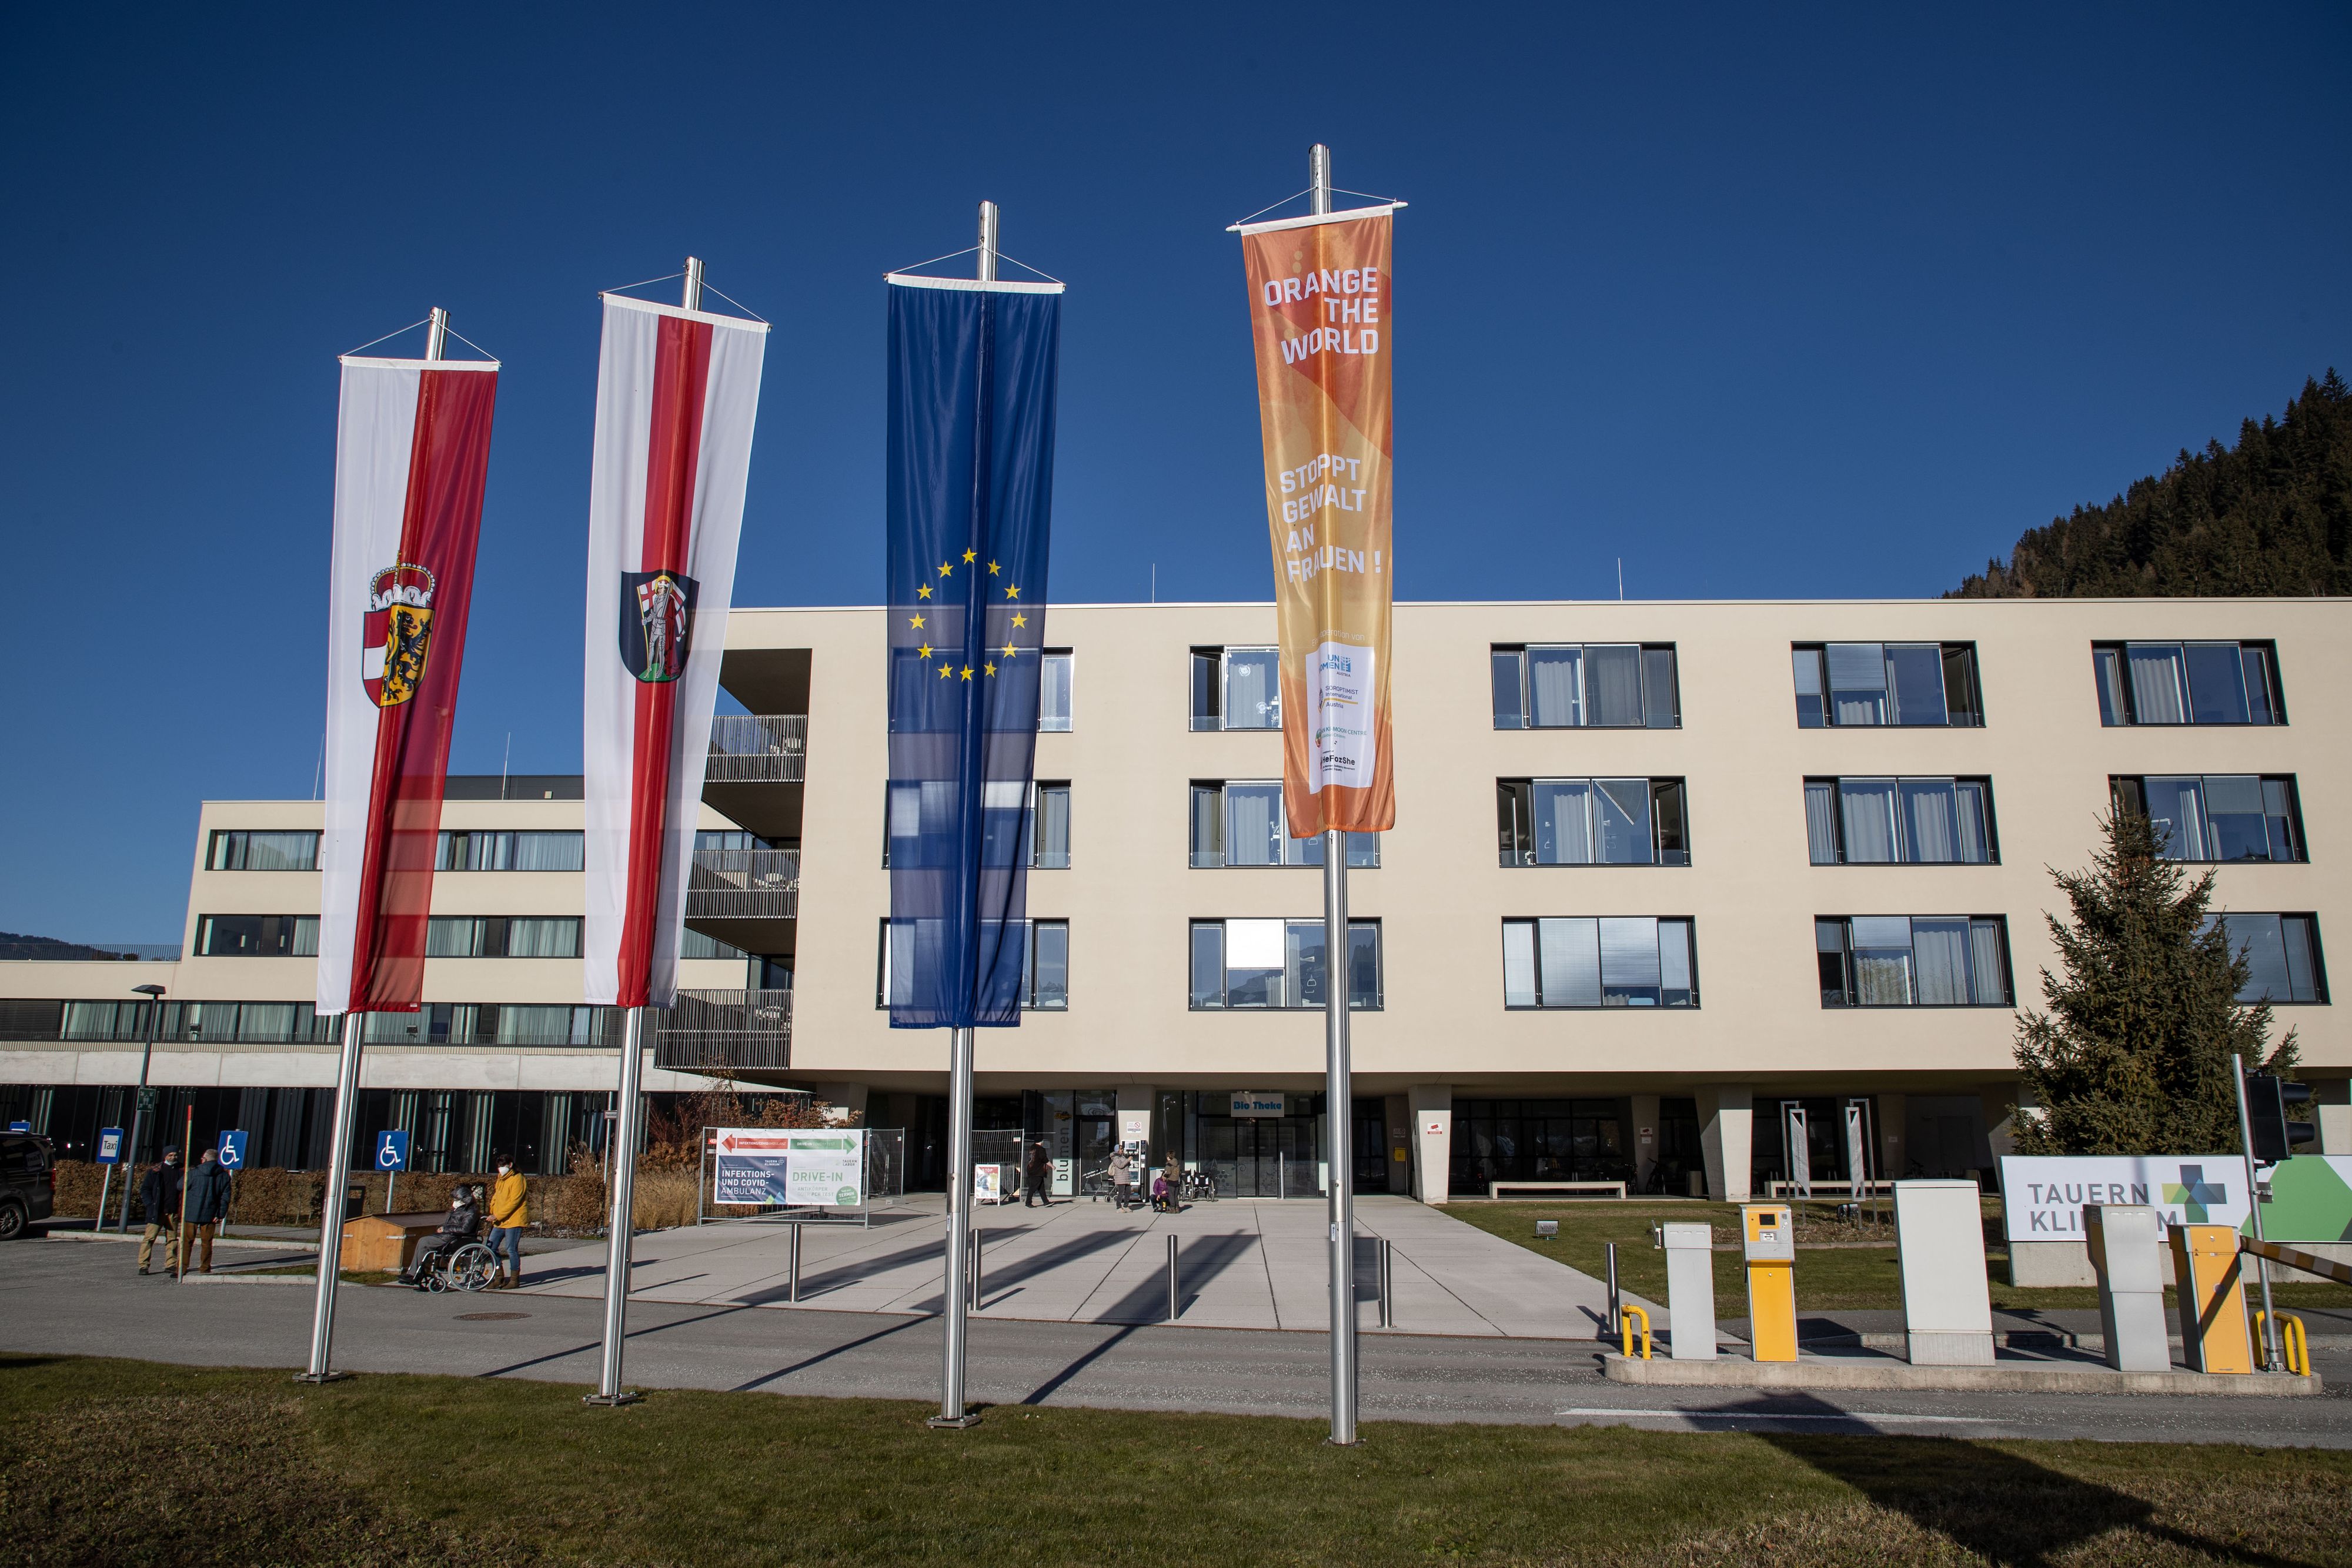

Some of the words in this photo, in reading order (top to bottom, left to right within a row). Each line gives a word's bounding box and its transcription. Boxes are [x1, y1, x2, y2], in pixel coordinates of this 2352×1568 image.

[1264, 267, 1378, 306] ORANGE
[1324, 297, 1378, 323] THE
[1281, 327, 1378, 365] WORLD
[1279, 453, 1360, 493] STOPPT
[1282, 484, 1367, 523] GEWALT
[1287, 523, 1314, 553] AN
[1287, 545, 1364, 583] FRAUEN
[1319, 662, 1339, 673] OMEN
[1325, 686, 1358, 695] SOROPTIMIST
[1322, 755, 1355, 765] HeForShe
[1234, 1101, 1250, 1110] Bio
[1252, 1101, 1282, 1110] Theke
[104, 1141, 118, 1150] Taxi
[1056, 1127, 1068, 1181] blumen
[722, 1170, 774, 1178] INFEKTIONS-
[793, 1172, 843, 1182] DRIVE-IN
[2027, 1183, 2149, 1204] TAUERN
[2030, 1211, 2177, 1232] KLIM
